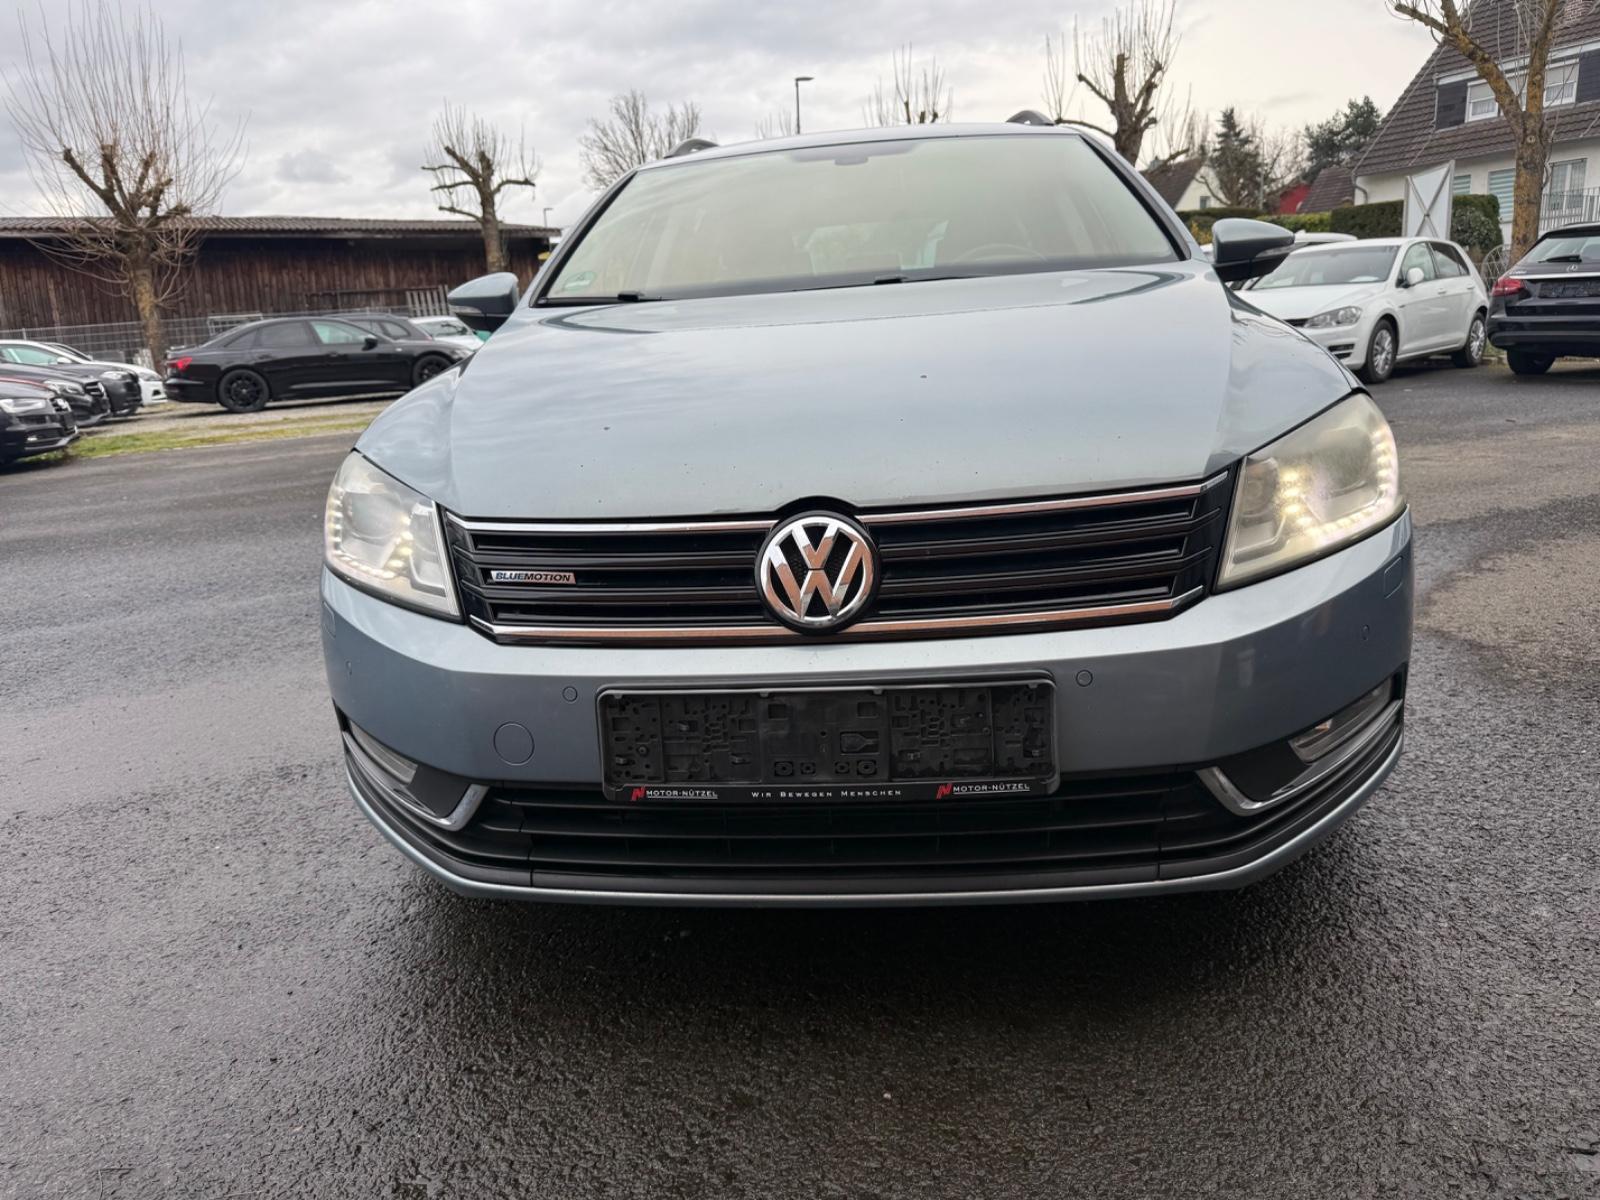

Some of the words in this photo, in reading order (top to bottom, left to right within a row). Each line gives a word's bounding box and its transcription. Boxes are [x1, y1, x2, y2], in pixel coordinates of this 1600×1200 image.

[767, 520, 867, 621] VW
[495, 572, 572, 582] BLUEMOTION
[953, 783, 1030, 792] MOTOR-NÜTZEL
[646, 789, 718, 798] MOTOR-NÜTZEL
